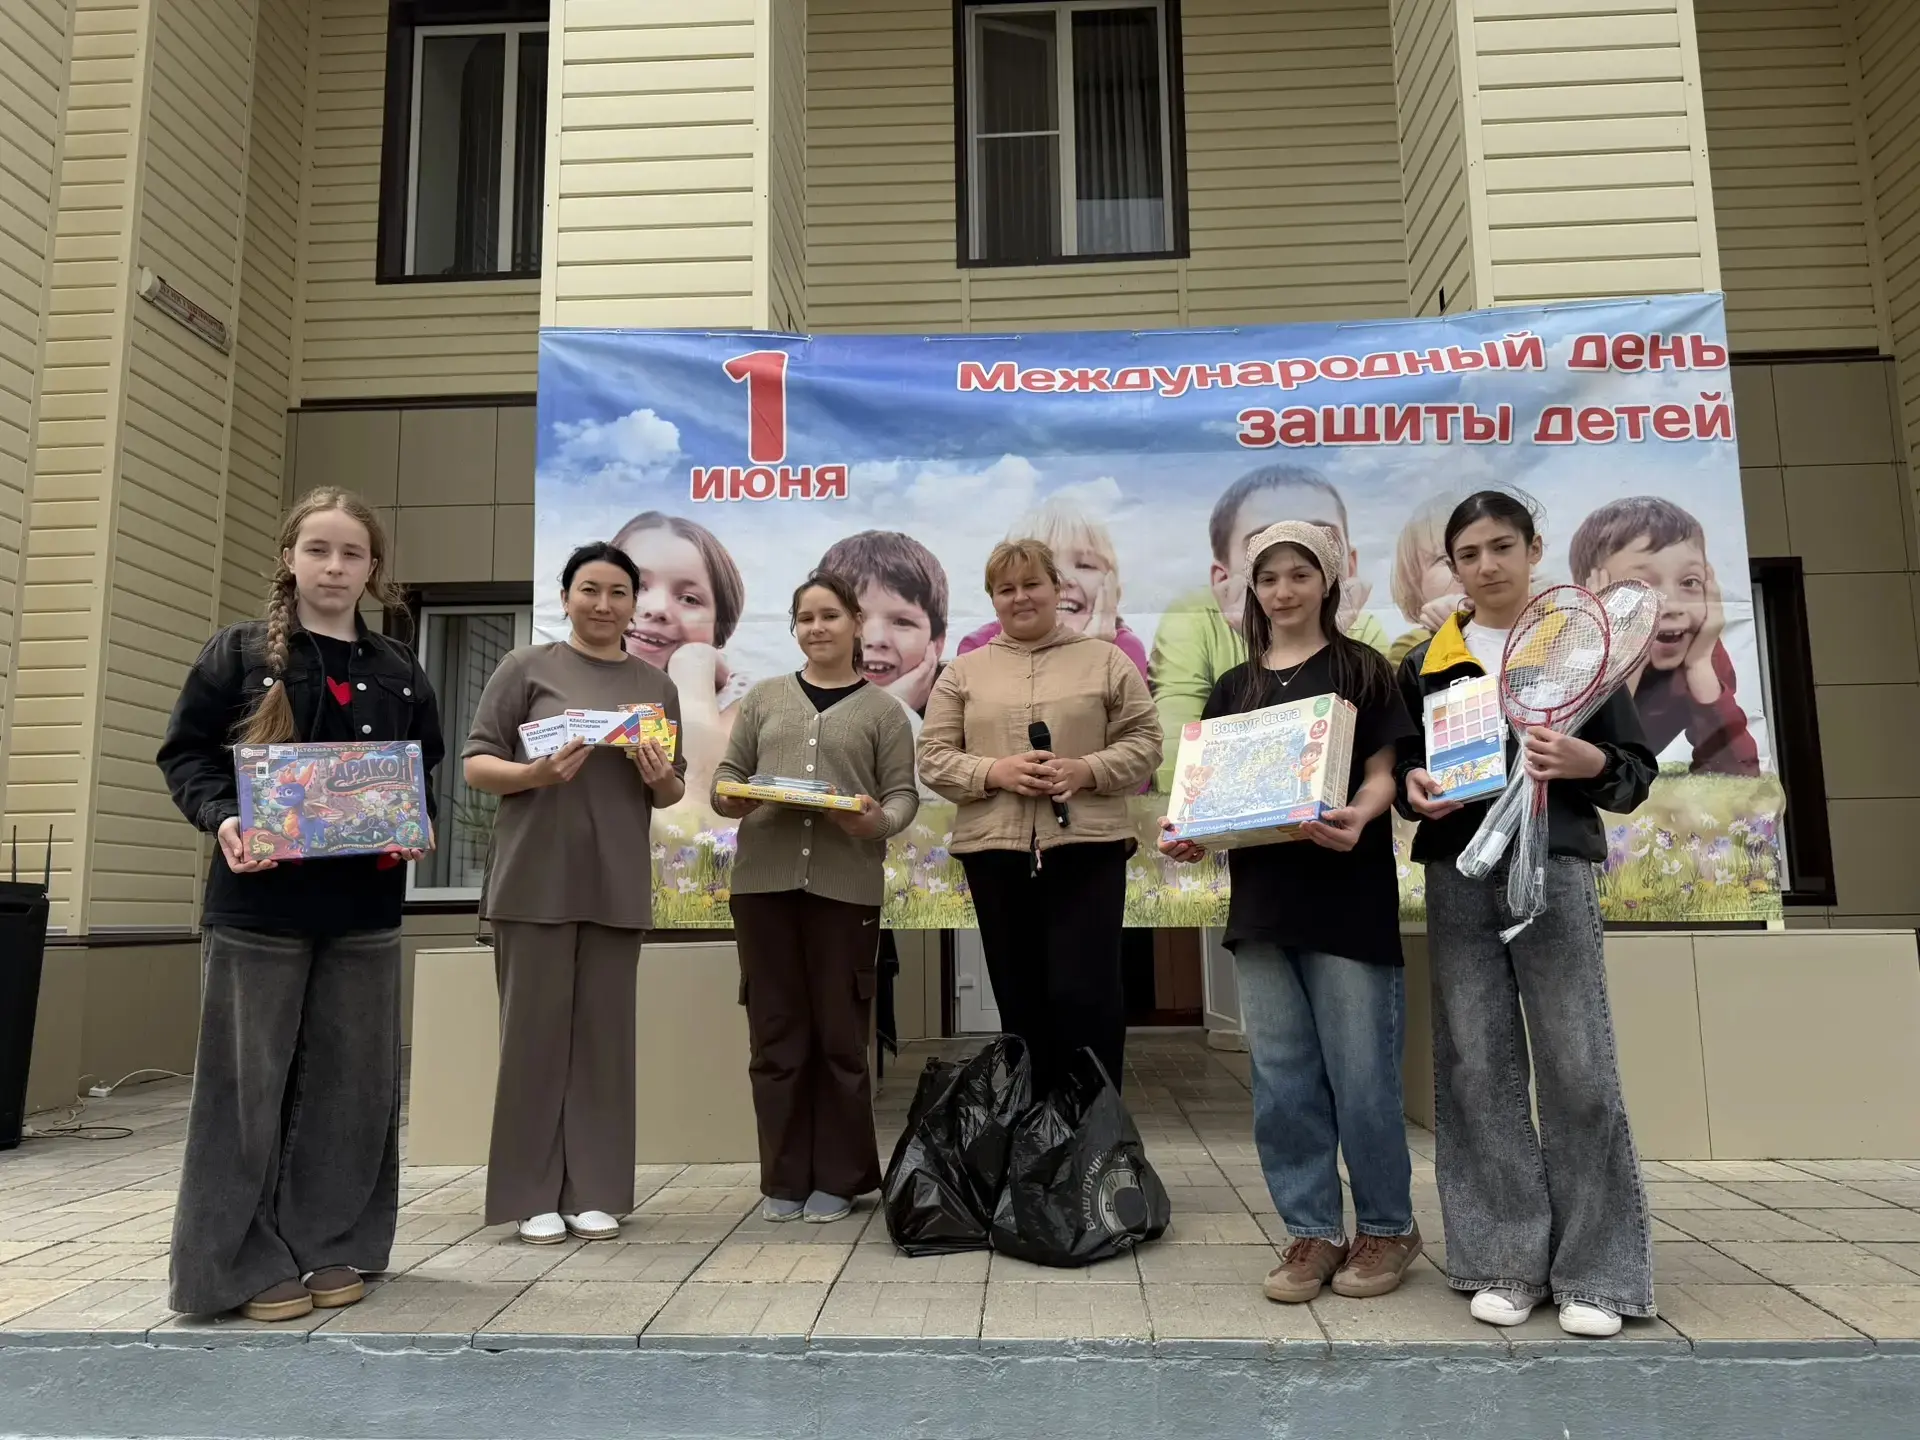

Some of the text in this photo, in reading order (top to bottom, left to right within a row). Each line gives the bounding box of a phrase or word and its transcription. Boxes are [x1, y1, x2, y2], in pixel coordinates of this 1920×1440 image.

[957, 330, 1727, 397] Международный день
[723, 350, 789, 464] 1
[1238, 391, 1733, 447] защиты детей
[691, 464, 848, 502] июня
[1212, 708, 1300, 736] Вокруг Света
[1082, 1196, 1097, 1231] ВАШ
